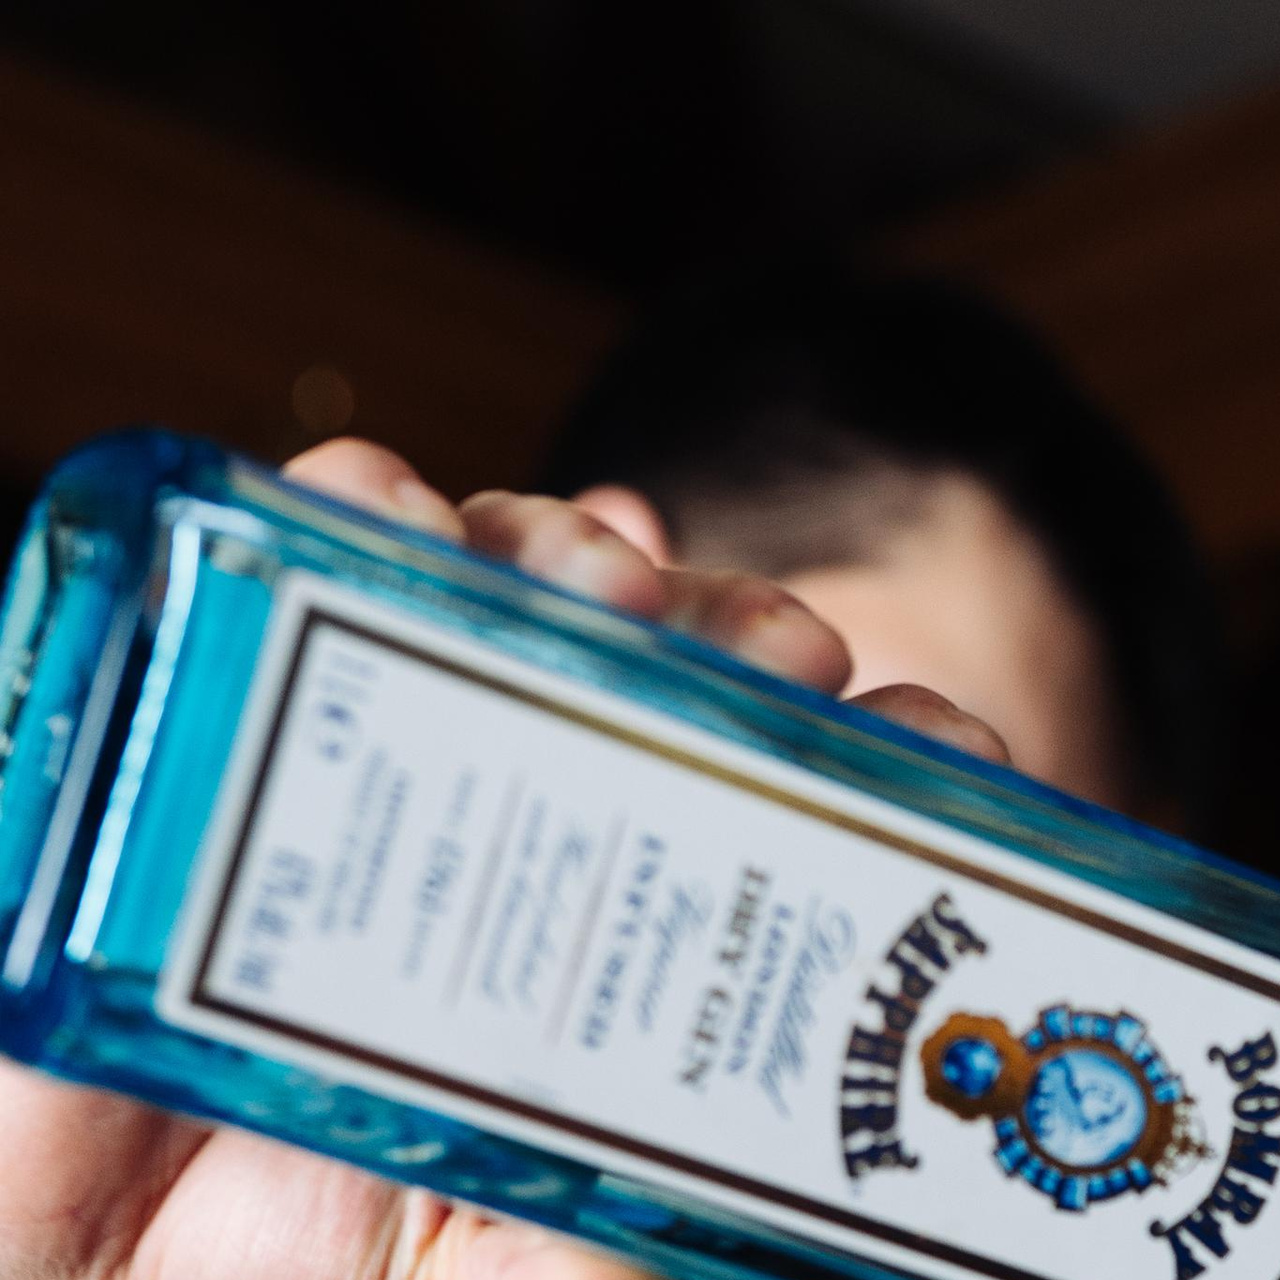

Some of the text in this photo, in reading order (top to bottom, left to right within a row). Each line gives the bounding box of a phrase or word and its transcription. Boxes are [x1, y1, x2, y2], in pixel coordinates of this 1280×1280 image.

[676, 860, 773, 1092] DRY GIN
[838, 893, 990, 1180] SAPPHIRE
